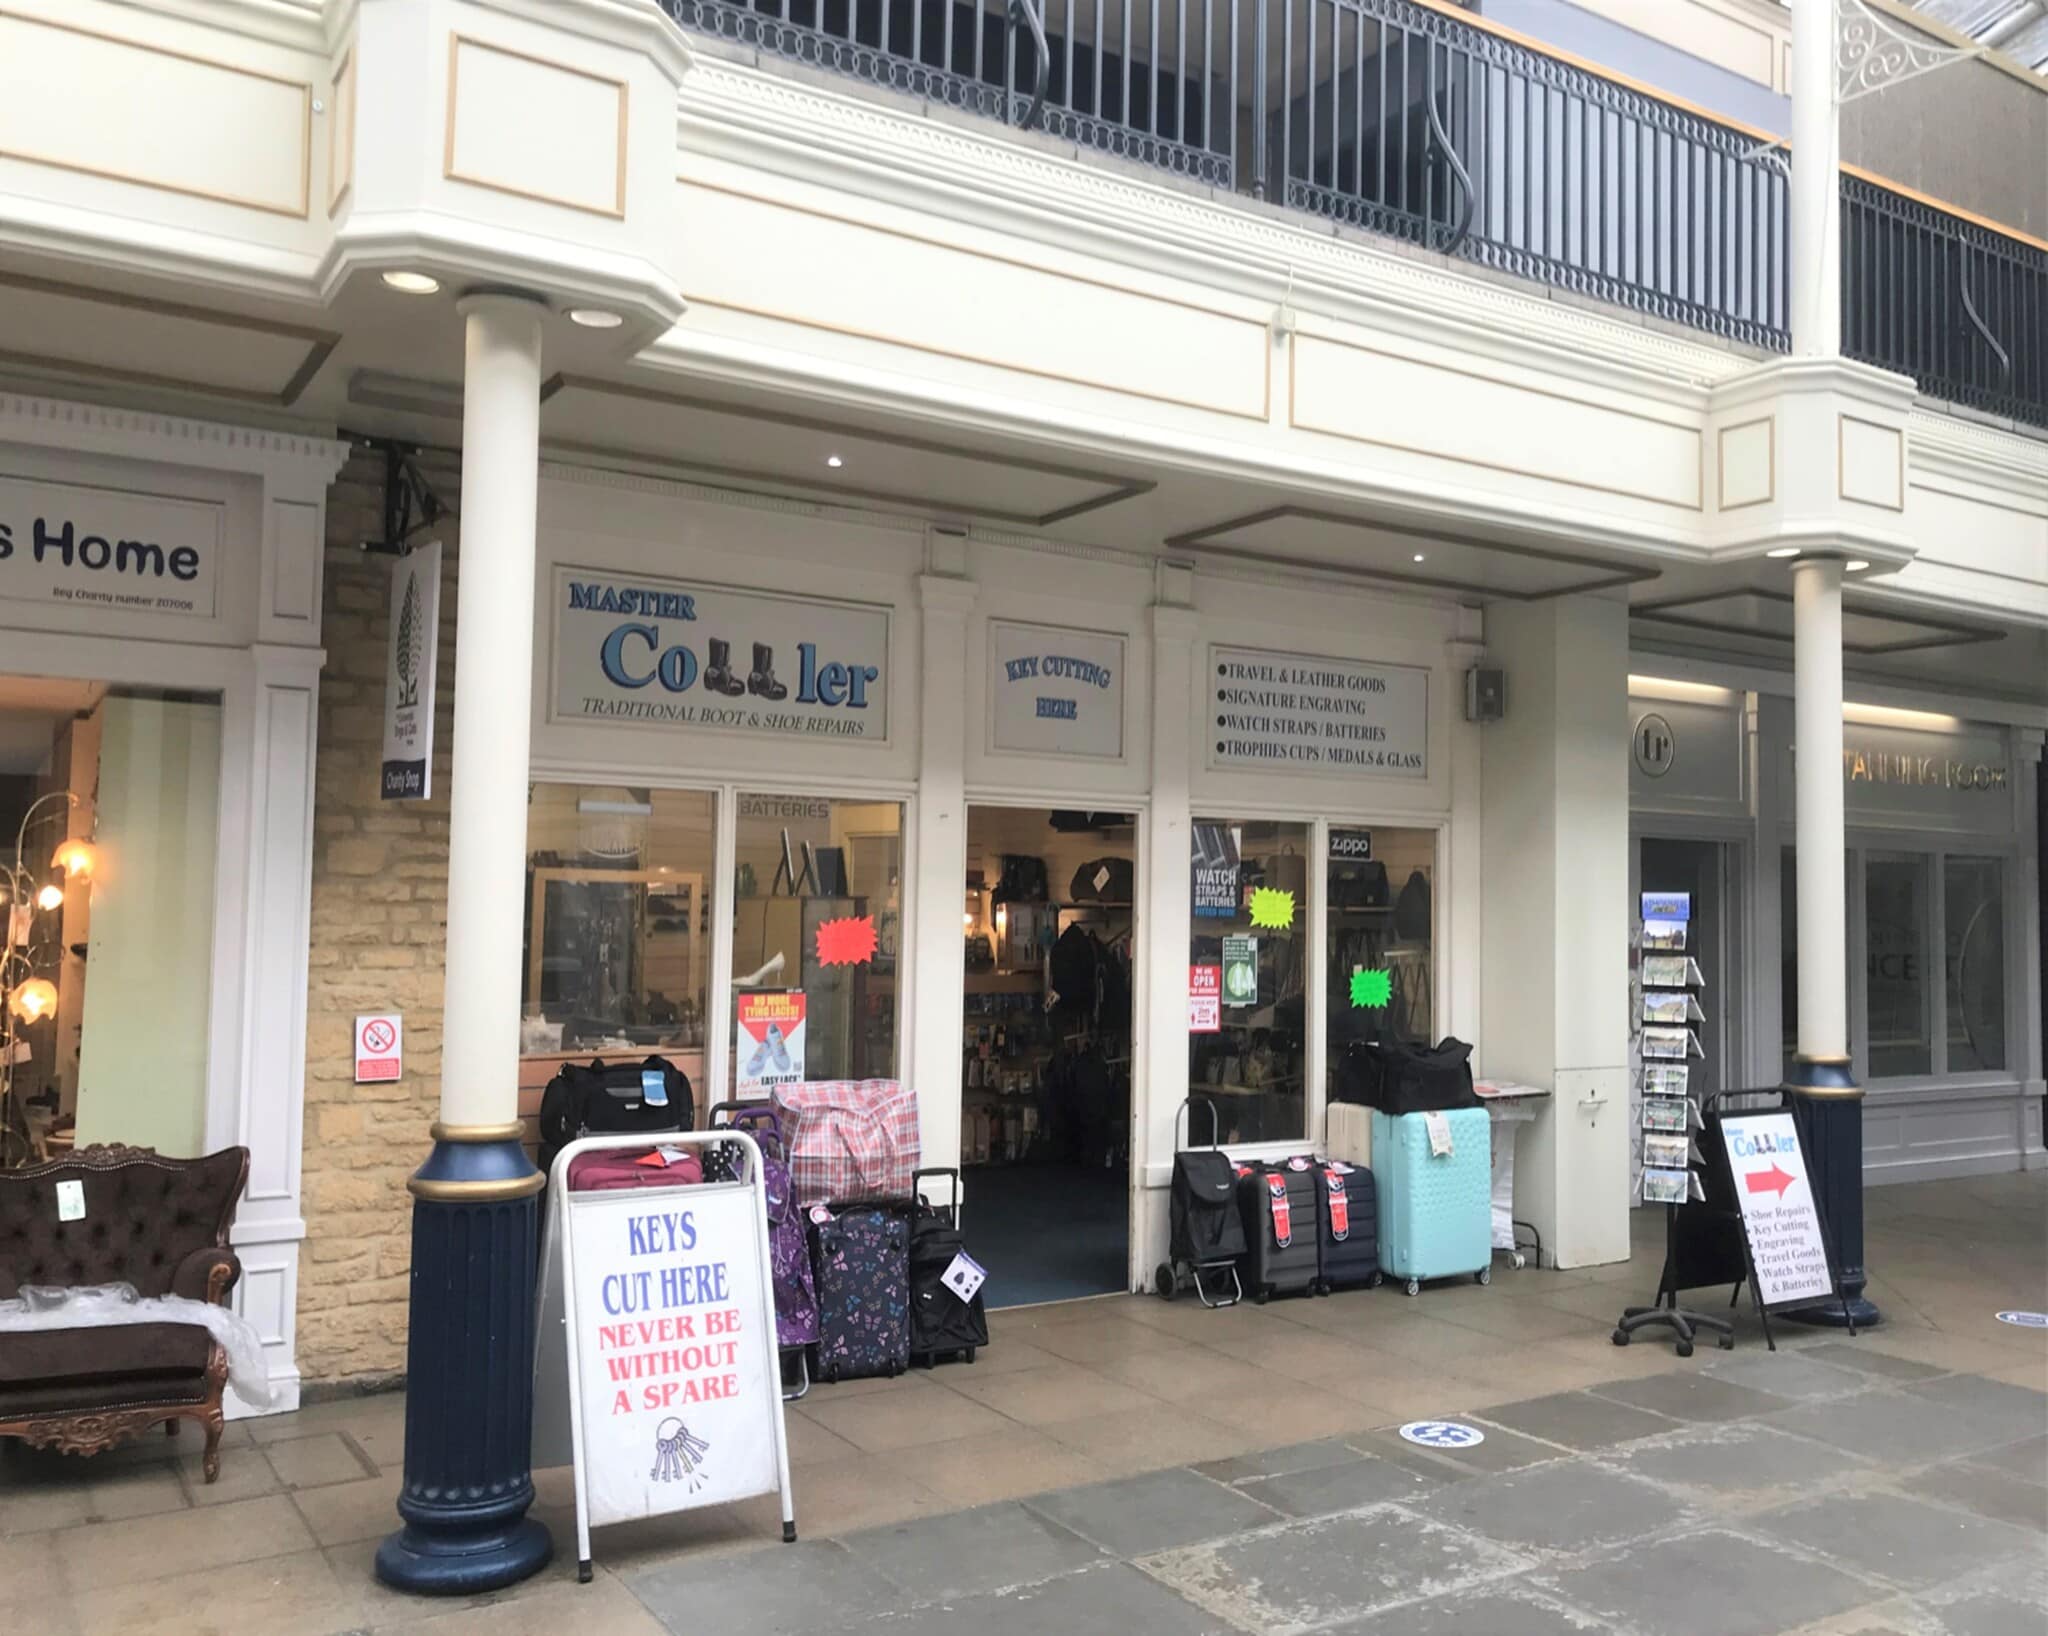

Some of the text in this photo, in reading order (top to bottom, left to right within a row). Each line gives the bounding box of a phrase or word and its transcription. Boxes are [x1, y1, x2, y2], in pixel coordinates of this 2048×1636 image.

[33, 517, 199, 580] Home
[53, 587, 72, 599] Reg
[76, 589, 112, 603] Charity
[115, 594, 152, 606] number
[568, 582, 696, 621] MASTER
[1005, 656, 1112, 689] KEY CUTTING
[1228, 663, 1386, 693] TRAVEL & LEATHER GOODS
[1036, 697, 1077, 720] HERE
[1226, 688, 1366, 715] SIGNATURE ENGRAVING
[581, 697, 865, 736] TRADITIONAL BOOT & SHOE REPAIRS
[1226, 715, 1270, 733] WATCH
[1273, 718, 1317, 736] STRAPS
[1326, 723, 1386, 741] BATTERIES
[1225, 740, 1287, 758] TROPHIES
[1289, 744, 1319, 761] CUPS
[1327, 749, 1374, 766] MEDALS
[1376, 752, 1384, 766] &
[1387, 752, 1422, 768] GLASS
[740, 800, 829, 818] BATTERIES
[1195, 868, 1236, 886] WATCH
[1195, 884, 1227, 897] STRAPS
[1195, 895, 1236, 908] BATTERIES
[1193, 975, 1215, 986] OPEN
[761, 1075, 779, 1086] EASY
[1751, 1205, 1811, 1221] Shoe Repairs
[627, 1211, 697, 1256] KEYS
[1753, 1218, 1809, 1236] Key Cutting
[1757, 1235, 1805, 1250] Engraving
[1760, 1247, 1821, 1265] Travel Goods
[1762, 1261, 1826, 1279] Watch Straps
[601, 1262, 730, 1316] CUT HERE
[1771, 1277, 1824, 1293] & Batteries
[599, 1308, 742, 1351] NEVER BE
[607, 1341, 738, 1382] WITHOUT
[611, 1373, 740, 1415] A SPARE
